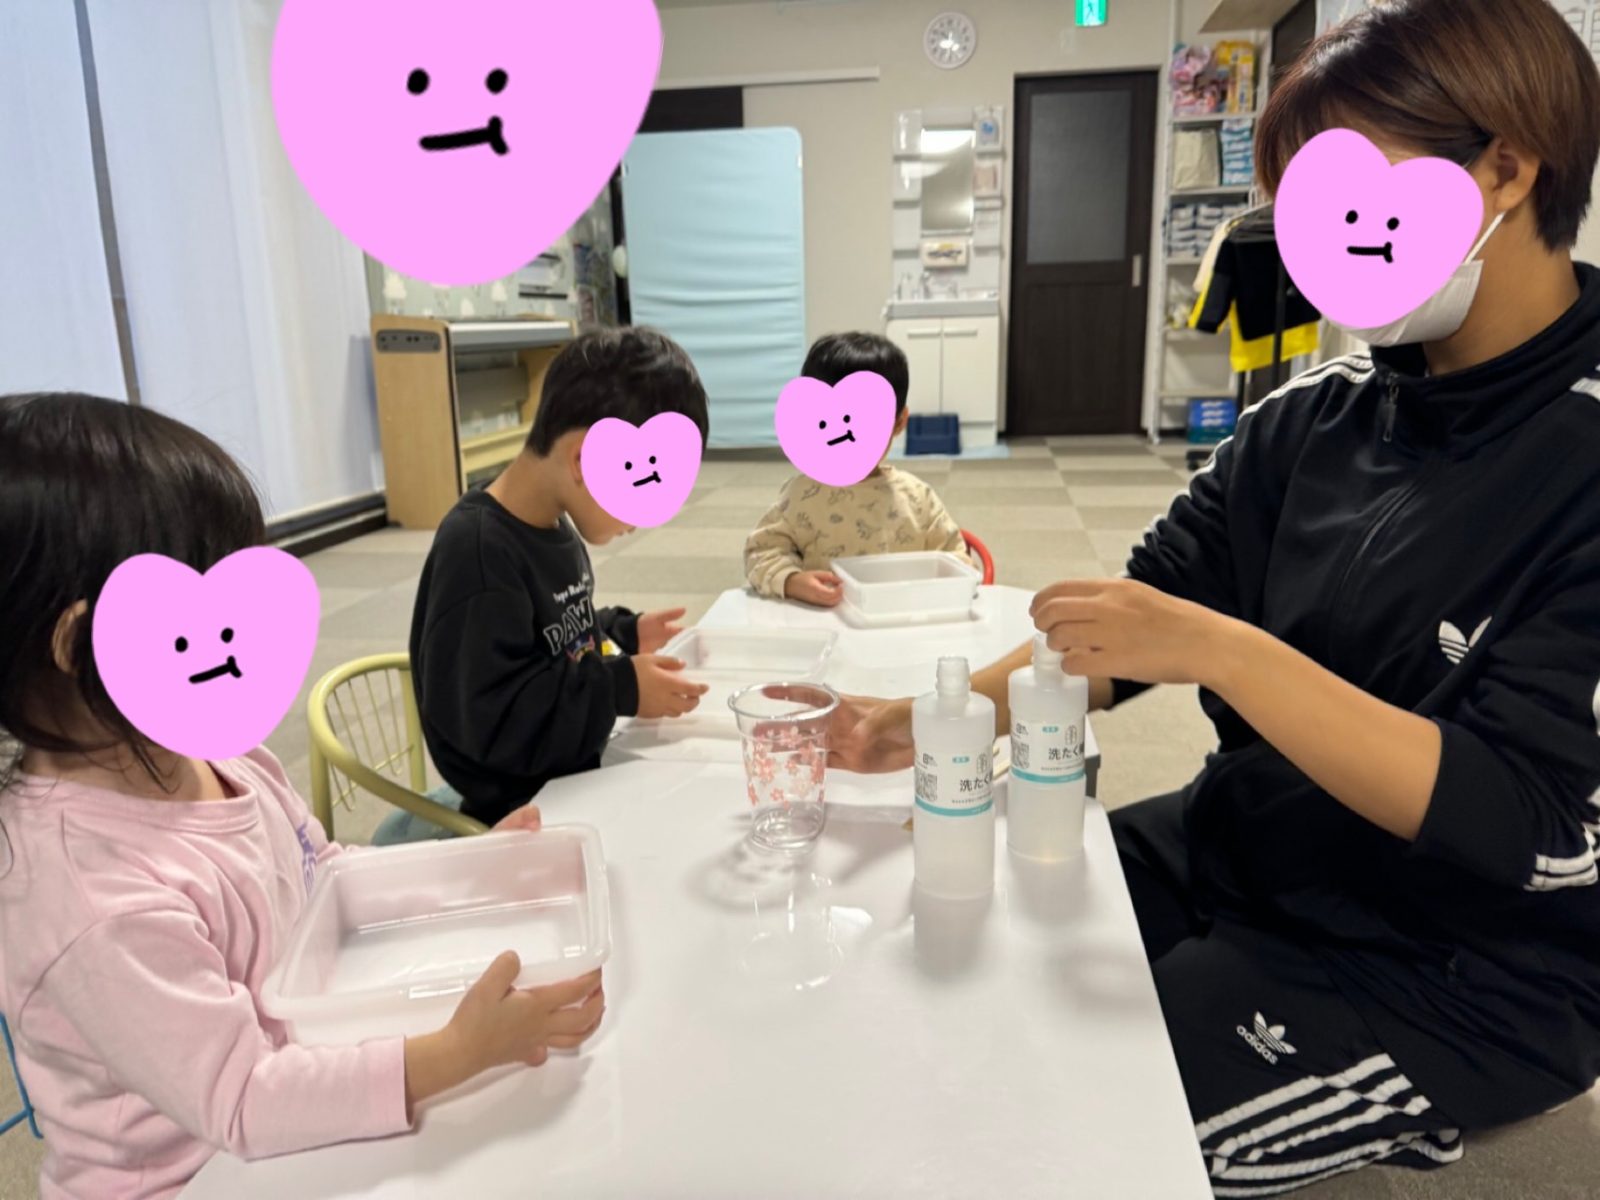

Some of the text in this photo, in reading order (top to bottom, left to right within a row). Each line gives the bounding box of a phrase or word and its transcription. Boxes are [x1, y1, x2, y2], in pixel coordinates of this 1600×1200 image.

[543, 597, 593, 655] PAW
[960, 771, 992, 792] 洗たく
[1236, 1025, 1278, 1064] adidas
